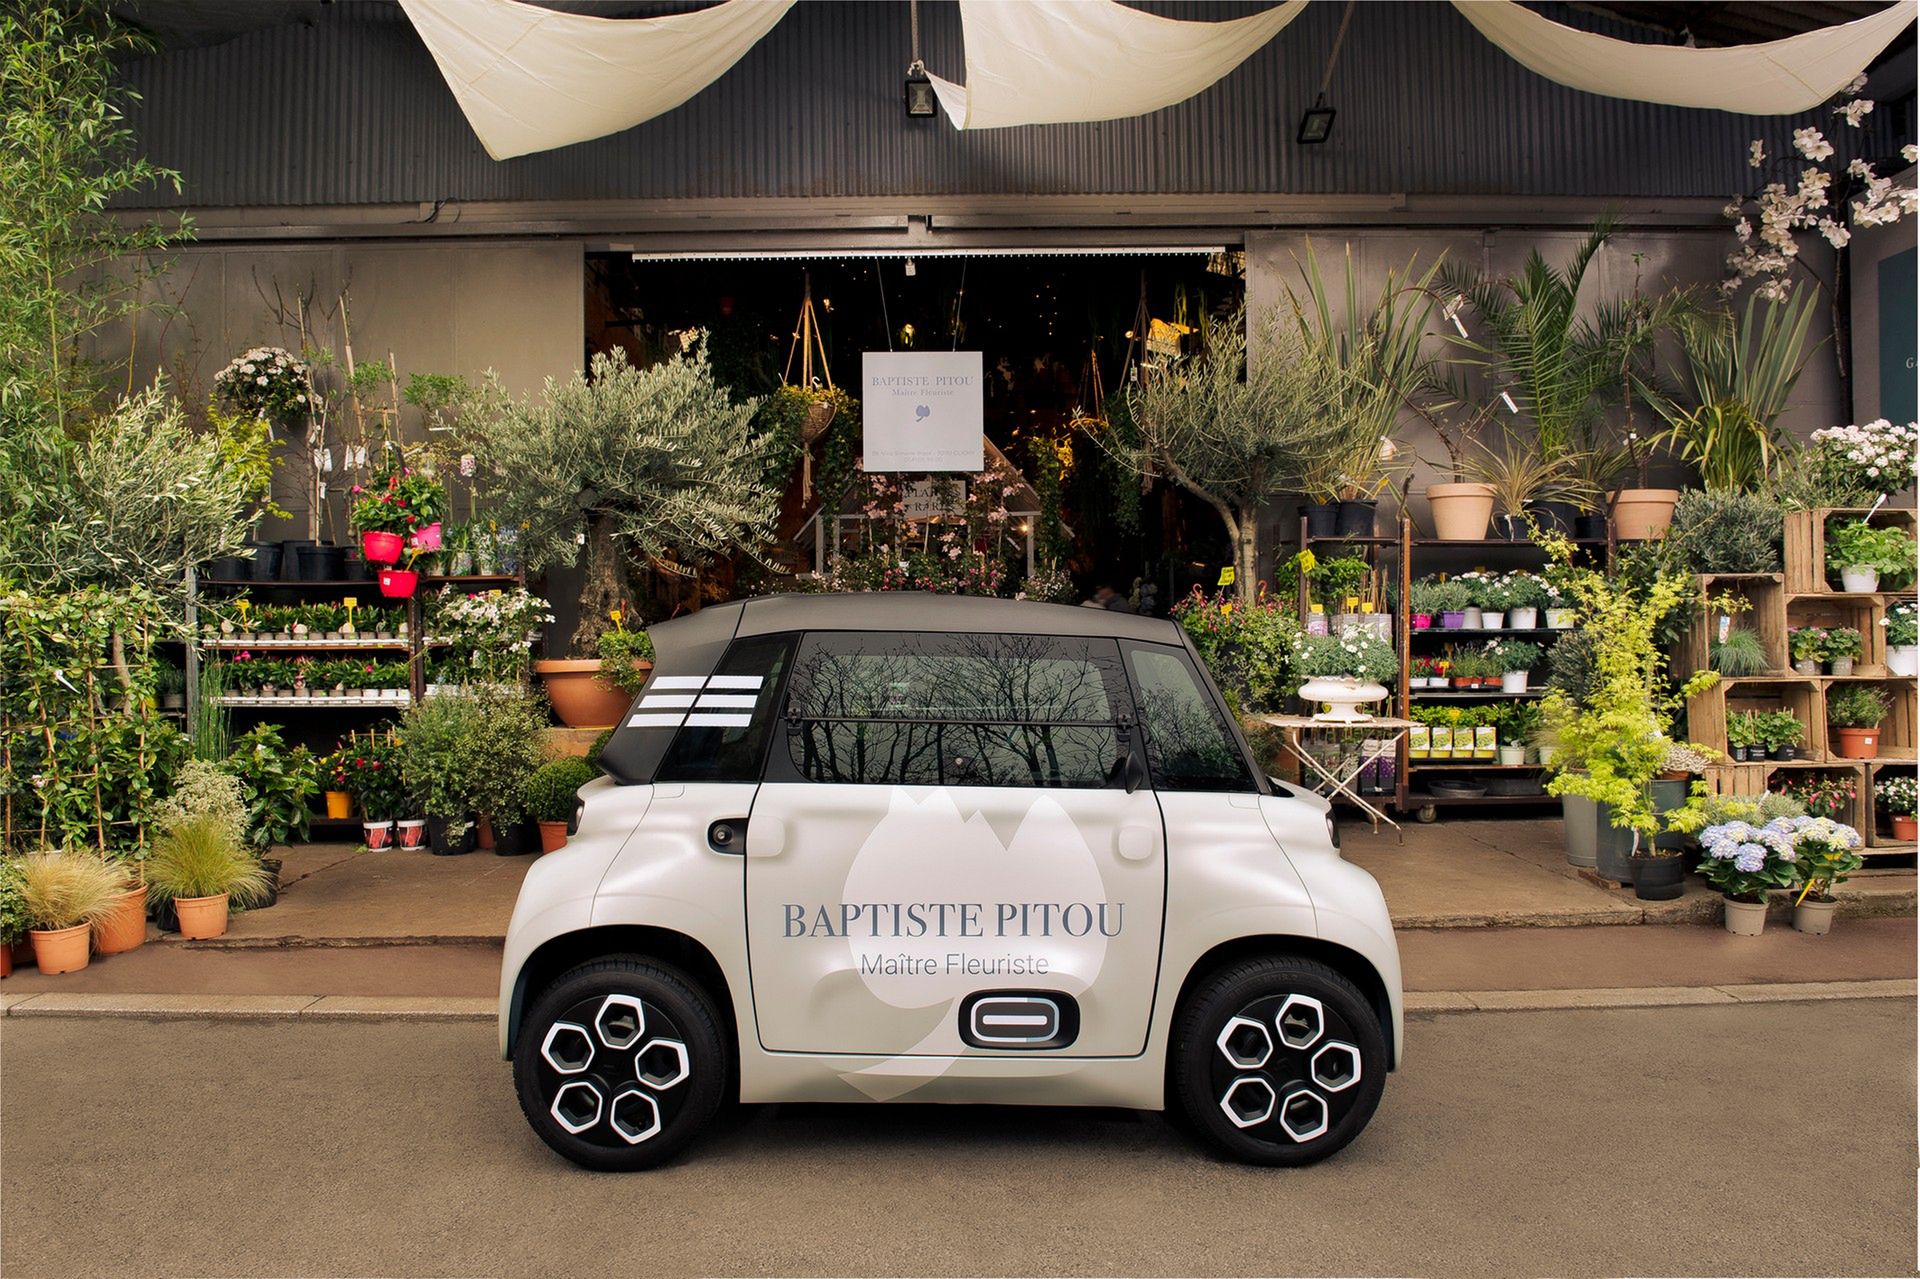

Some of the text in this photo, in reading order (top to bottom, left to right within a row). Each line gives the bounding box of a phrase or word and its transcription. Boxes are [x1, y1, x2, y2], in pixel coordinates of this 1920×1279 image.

[872, 376, 974, 386] BAPTISTE PITOU
[892, 388, 954, 396] Maître Fleuriste
[782, 902, 1126, 938] BAPTISTE PITOU
[861, 952, 1049, 975] Maître Fleuriste
